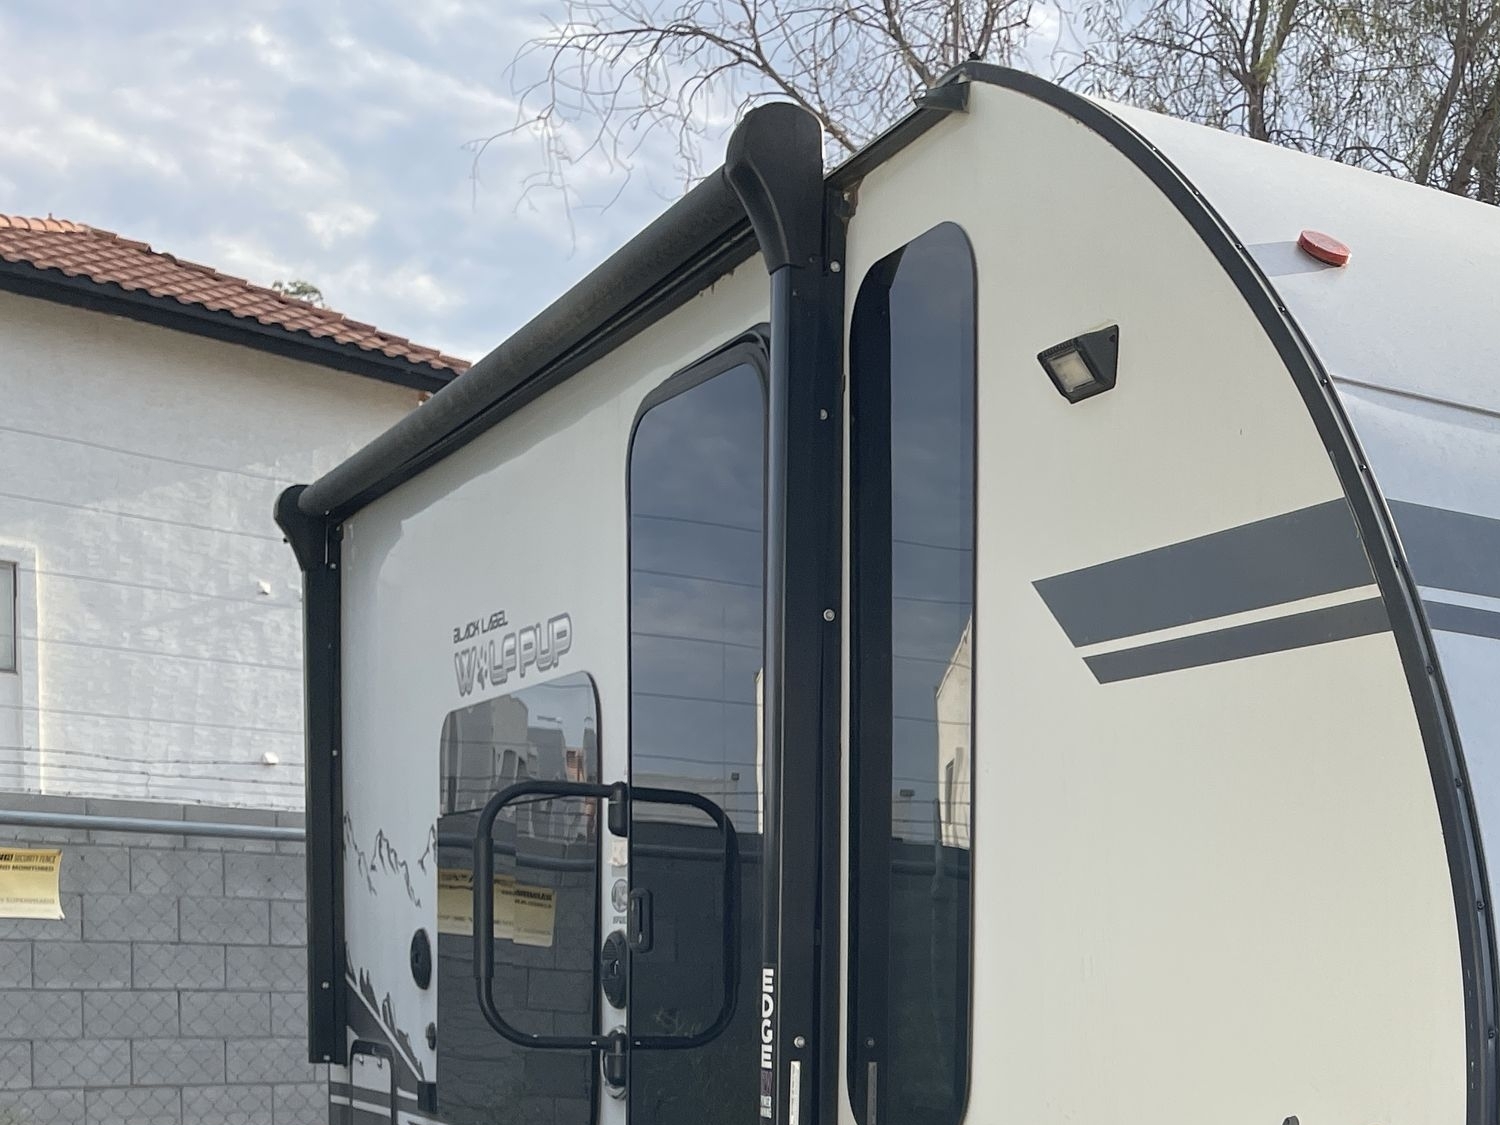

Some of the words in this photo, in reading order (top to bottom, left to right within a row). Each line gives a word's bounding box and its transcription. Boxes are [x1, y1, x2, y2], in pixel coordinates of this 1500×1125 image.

[453, 620, 481, 645] BLACK
[481, 610, 509, 636] LABEL
[519, 612, 572, 678] PUP
[760, 967, 775, 1069] EDGE
